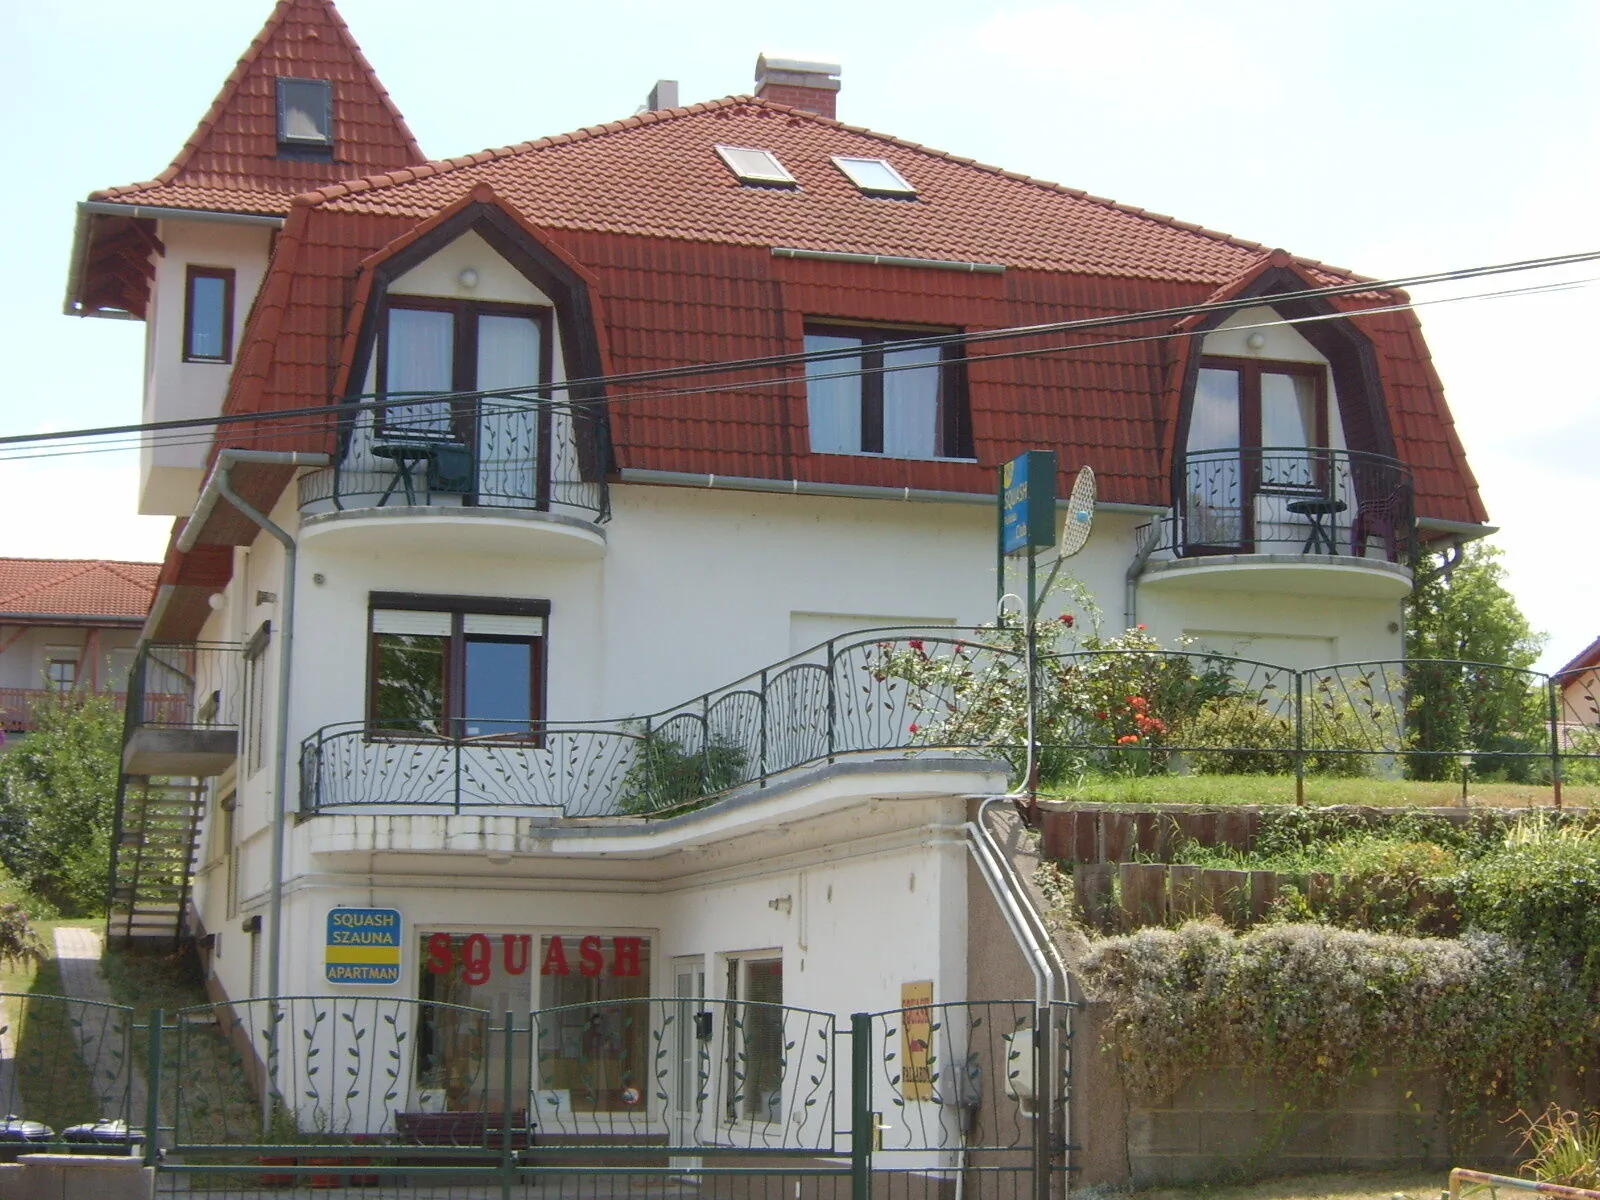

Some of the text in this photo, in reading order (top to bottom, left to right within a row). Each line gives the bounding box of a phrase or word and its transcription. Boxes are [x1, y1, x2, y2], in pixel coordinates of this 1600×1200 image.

[333, 913, 394, 928] SQUASH
[332, 931, 393, 944] SZAUNA
[427, 932, 643, 986] SQUASH
[328, 966, 397, 979] APARTMAN
